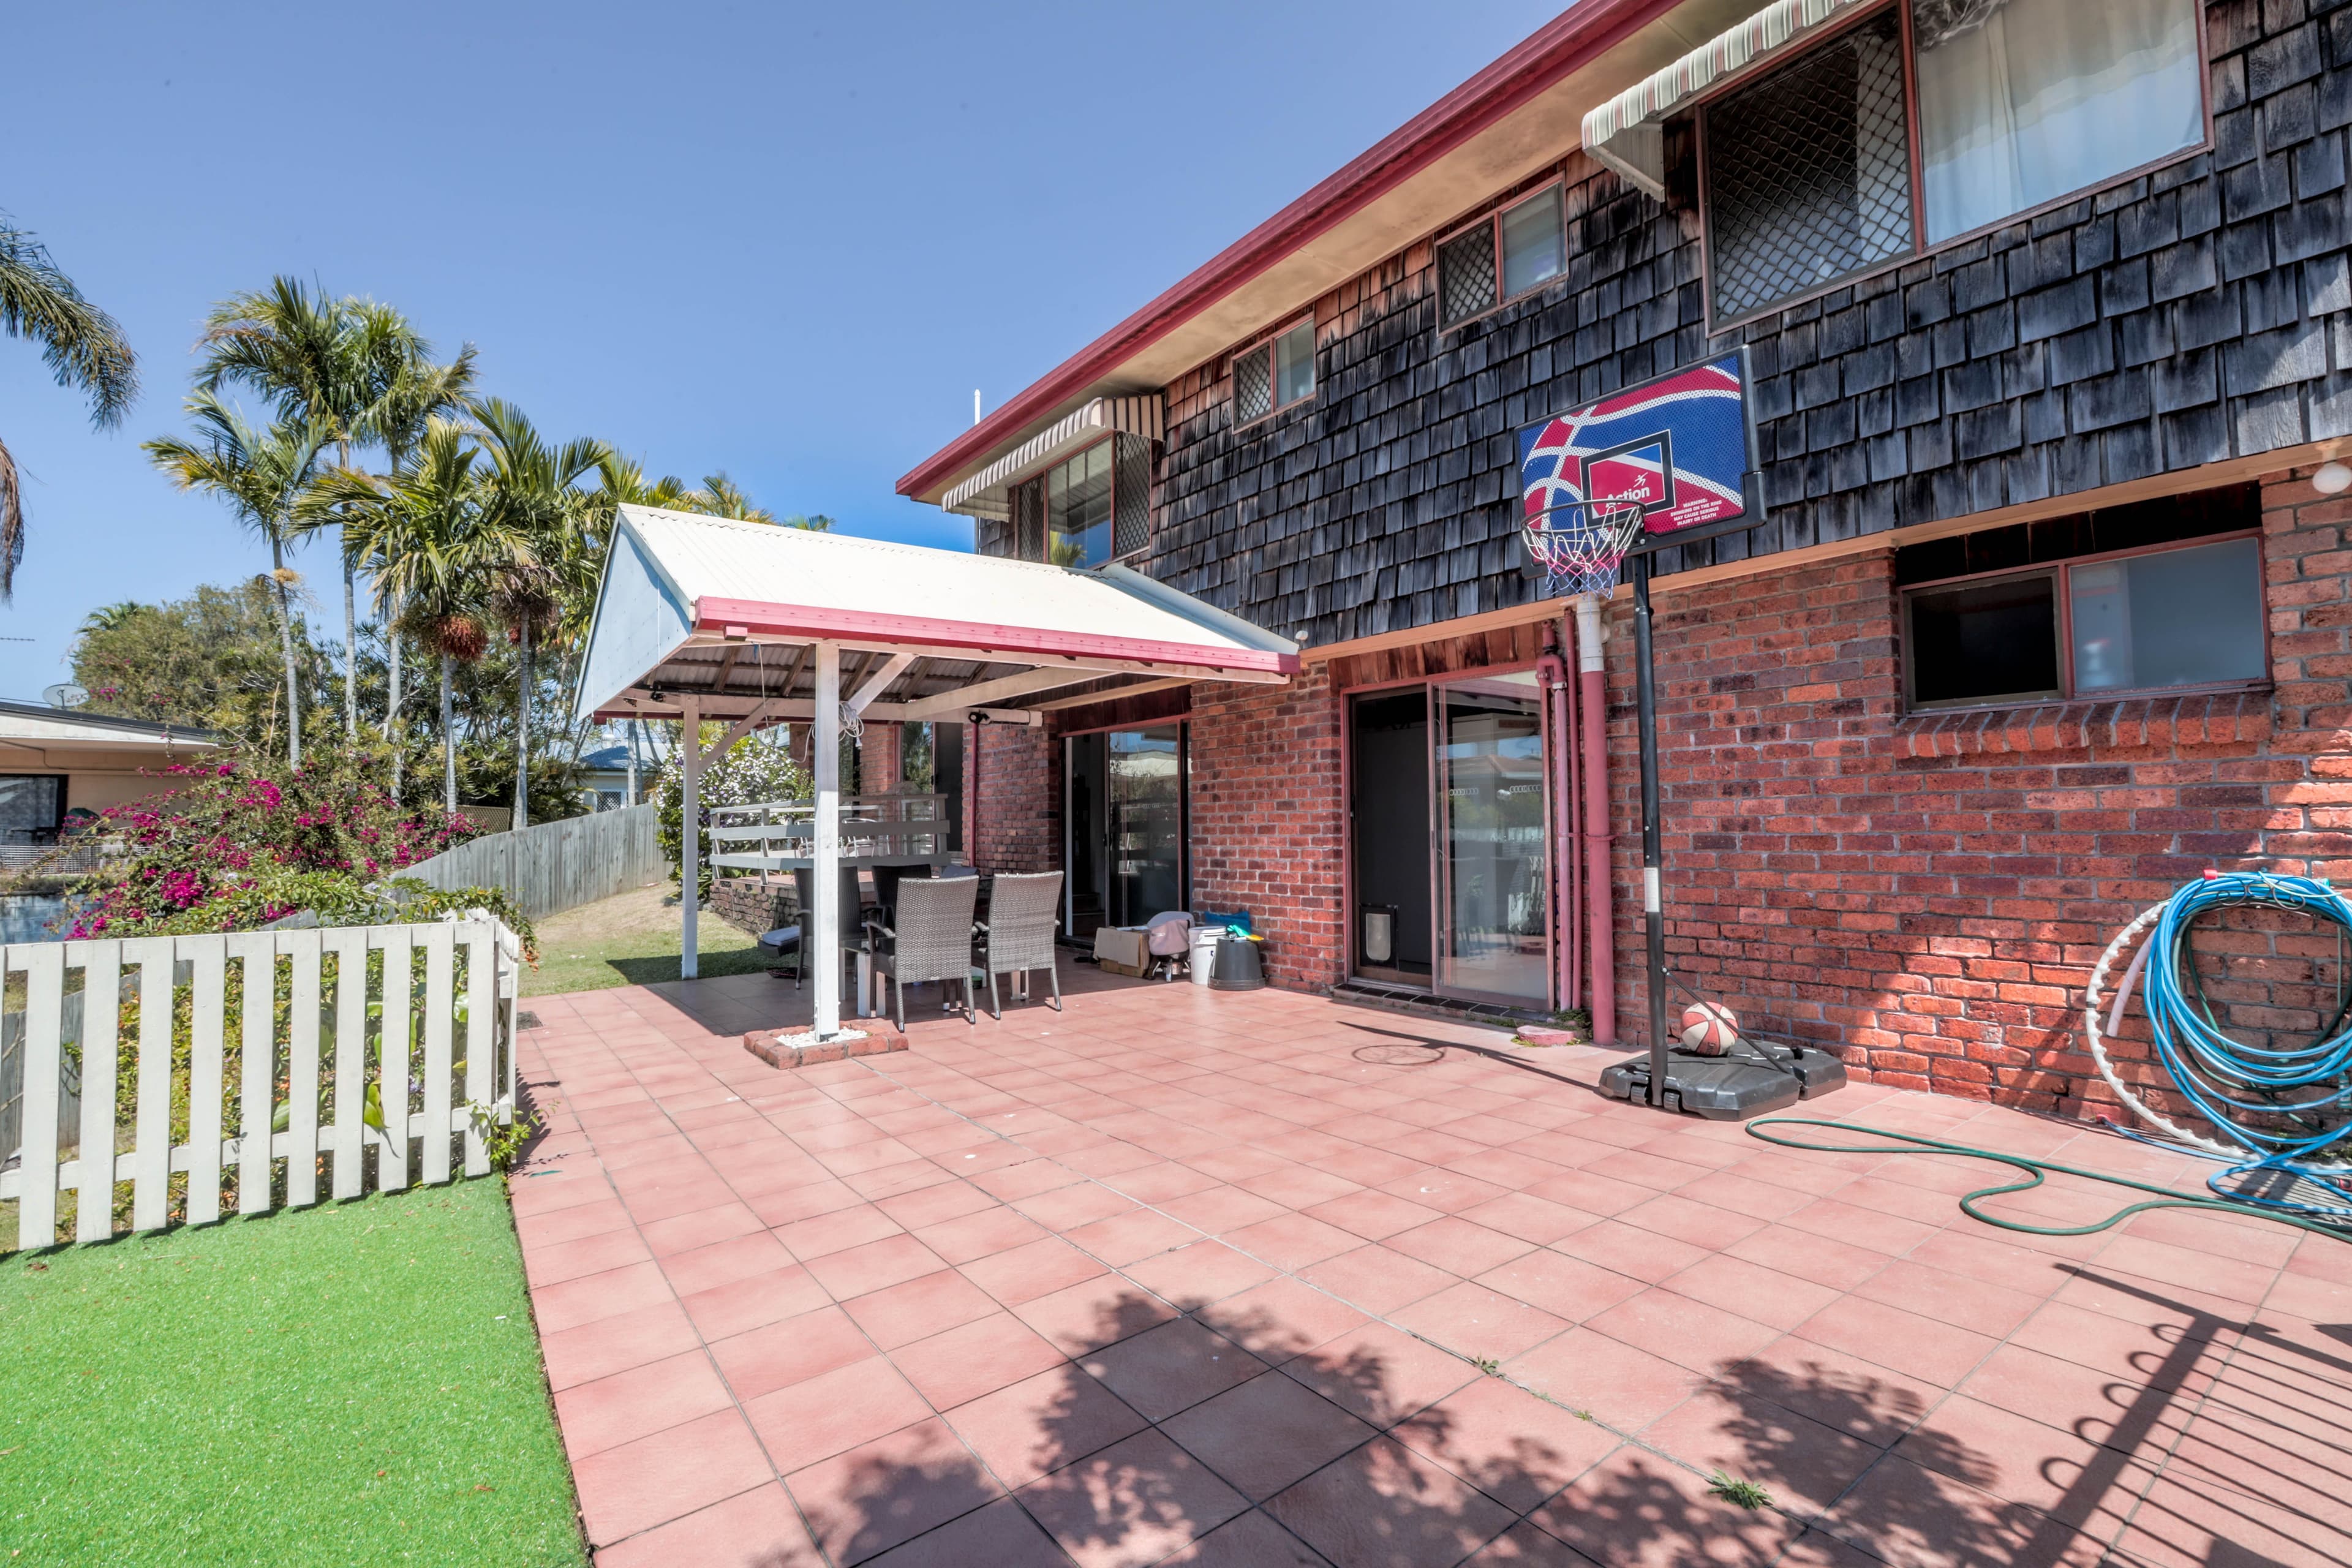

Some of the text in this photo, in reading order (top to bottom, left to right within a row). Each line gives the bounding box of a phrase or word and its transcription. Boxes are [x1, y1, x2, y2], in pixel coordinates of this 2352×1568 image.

[1605, 486, 1650, 508] Action
[1683, 498, 1708, 508] WARNING:
[1670, 508, 1692, 517] SWINGING
[1700, 506, 1719, 514] SERIOUS
